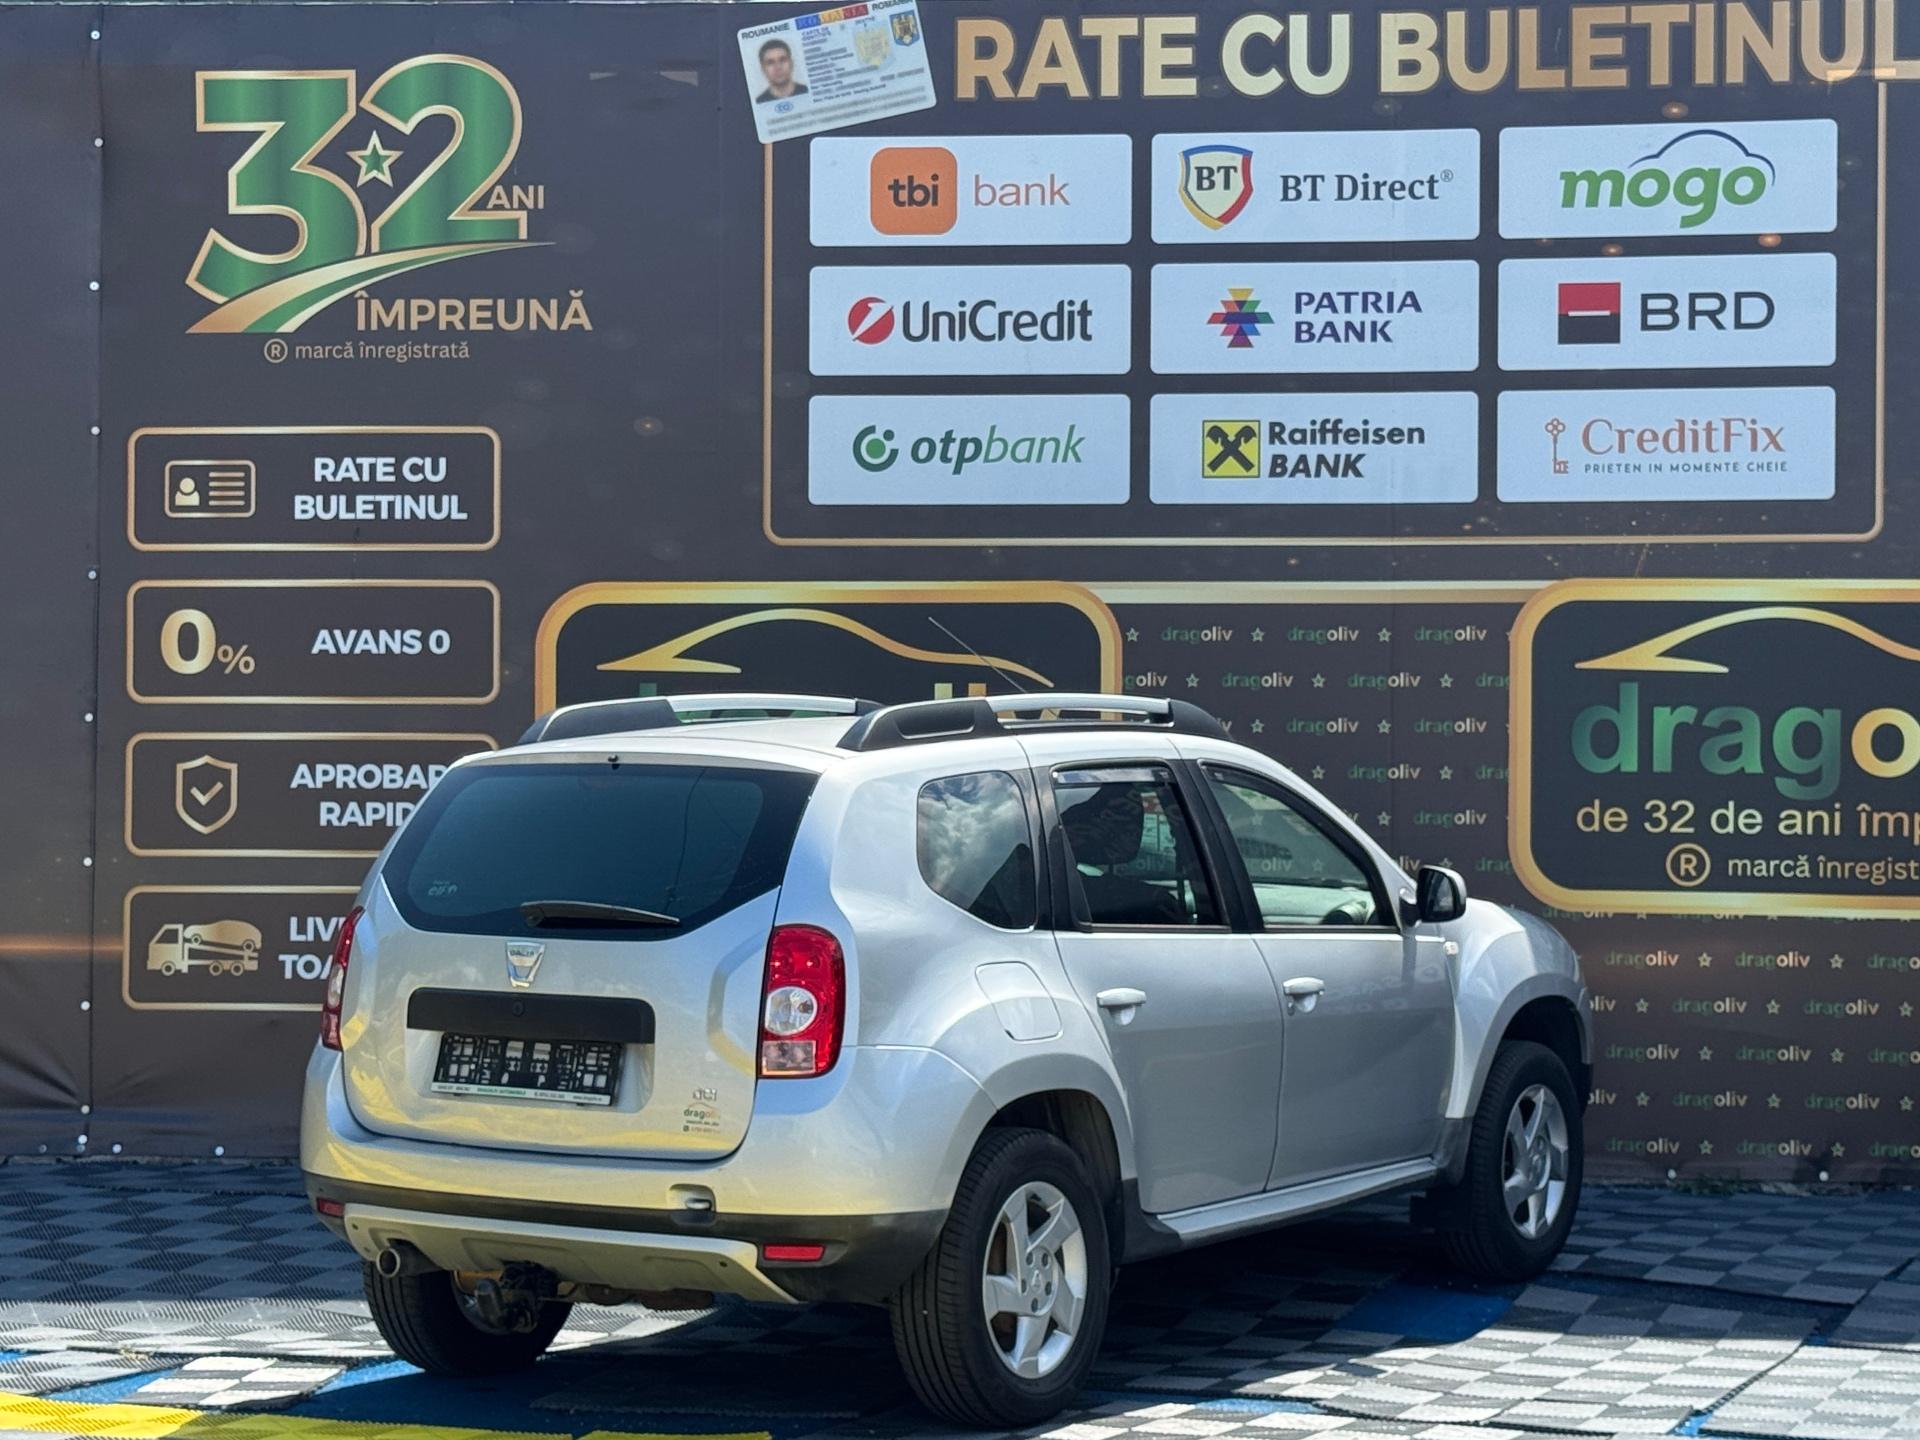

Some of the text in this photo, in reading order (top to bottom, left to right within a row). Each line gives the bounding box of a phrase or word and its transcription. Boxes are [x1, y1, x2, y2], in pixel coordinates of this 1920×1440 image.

[956, 16, 1197, 98] RATE
[1222, 13, 1350, 96] CU
[1380, 0, 1920, 94] BULETINUL
[185, 53, 527, 304] 32
[888, 173, 1070, 207] tbi bank
[1194, 165, 1239, 191] BT
[1280, 174, 1325, 202] BT
[487, 185, 545, 209] ANI
[1559, 166, 1766, 228] mogo
[354, 289, 593, 331] ÎMPREUNĂ
[1295, 291, 1422, 314] PATRIA
[1640, 291, 1775, 331] BRD
[902, 300, 1093, 342] UniCredit
[1295, 320, 1392, 343] BANK
[295, 341, 354, 360] marcă
[359, 340, 470, 363] înregistrată
[1268, 418, 1425, 445] Raiffeisen
[1582, 418, 1785, 455] CreditFix
[910, 424, 1086, 475] otpbank
[314, 457, 447, 483] RATE CU
[1268, 454, 1366, 478] BANK
[1584, 461, 1788, 474] PRIETEN IN MOMENTE CHEIE
[294, 494, 468, 520] BULETINUL
[160, 608, 256, 675] 0%
[311, 629, 450, 655] AVANS 0
[1161, 626, 1487, 644] dragoliv dragoliv dragoliv
[1124, 672, 1421, 690] goliv dragoliv dragoliv
[1286, 717, 1487, 735] dragoliv dragoliv
[1347, 764, 1421, 782] dragoliv
[1413, 810, 1487, 828] dragoliv
[1576, 799, 1628, 833] de
[1643, 800, 1695, 834] 32
[1710, 800, 1763, 835] de
[1778, 802, 1841, 836] ani
[1728, 854, 1811, 879] marcă
[290, 916, 346, 941] LIV
[1605, 950, 1680, 969] dragoliv
[1735, 951, 1810, 970] dragoliv
[1672, 997, 1879, 1017] dragoliv dragoliv
[1605, 1044, 1680, 1063] dragoliv
[1735, 1046, 1811, 1064] dragoliv
[1672, 1091, 1880, 1112] dragoliv dragoliv
[1606, 1138, 1680, 1157] dragoliv
[1736, 1140, 1812, 1158] dragoliv
